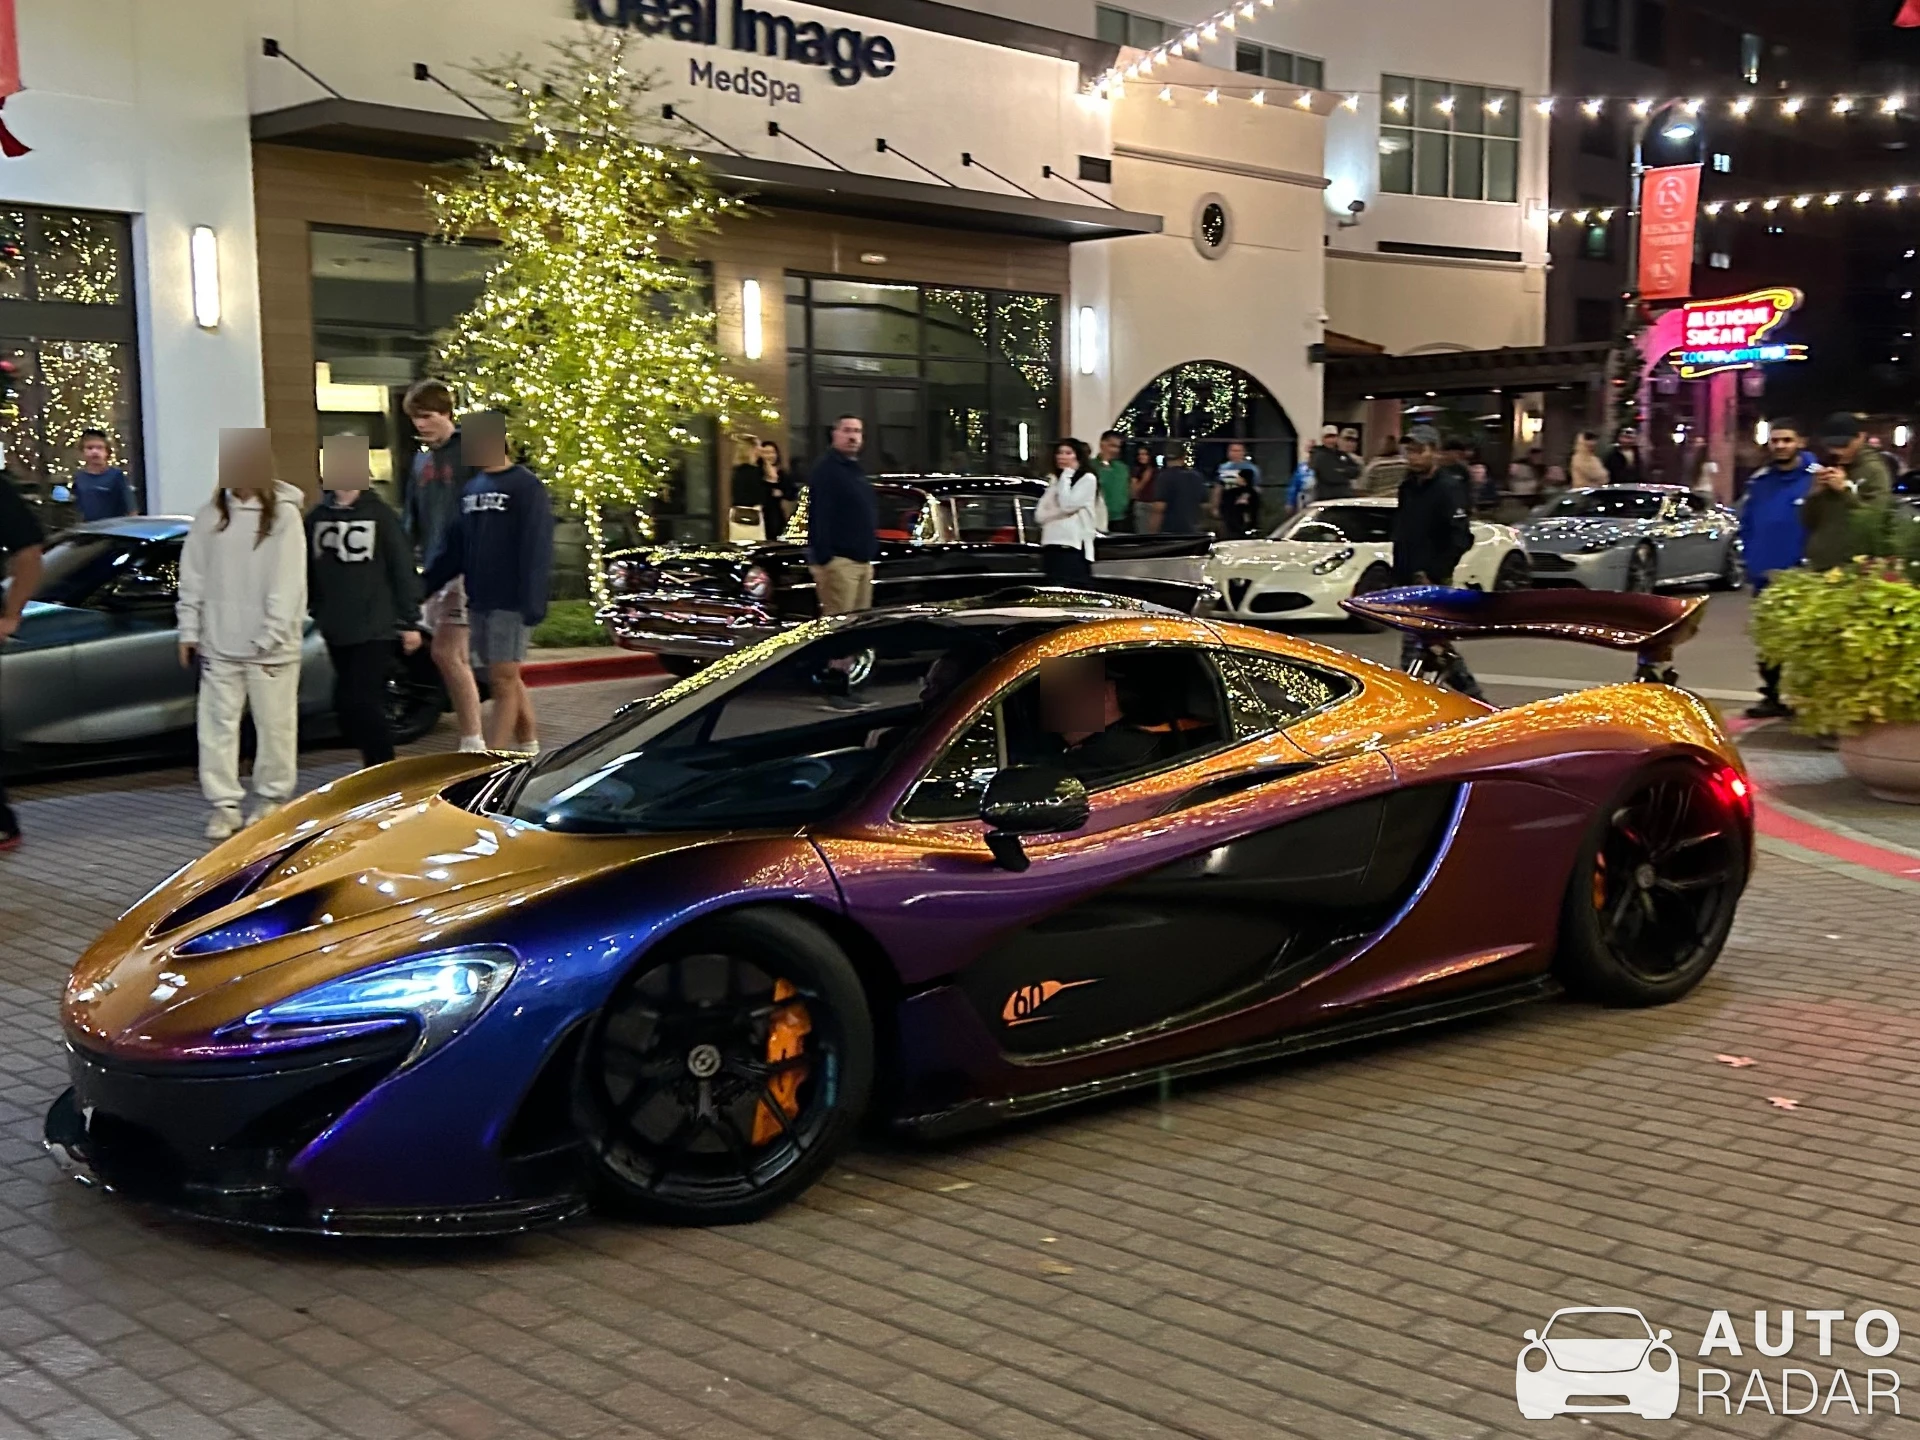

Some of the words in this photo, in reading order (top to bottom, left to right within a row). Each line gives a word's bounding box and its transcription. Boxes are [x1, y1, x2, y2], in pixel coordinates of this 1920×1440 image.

[732, 0, 896, 87] Image
[690, 58, 802, 105] MedSpa
[1686, 307, 1770, 328] MEXICAN
[1686, 327, 1747, 346] SUGAR
